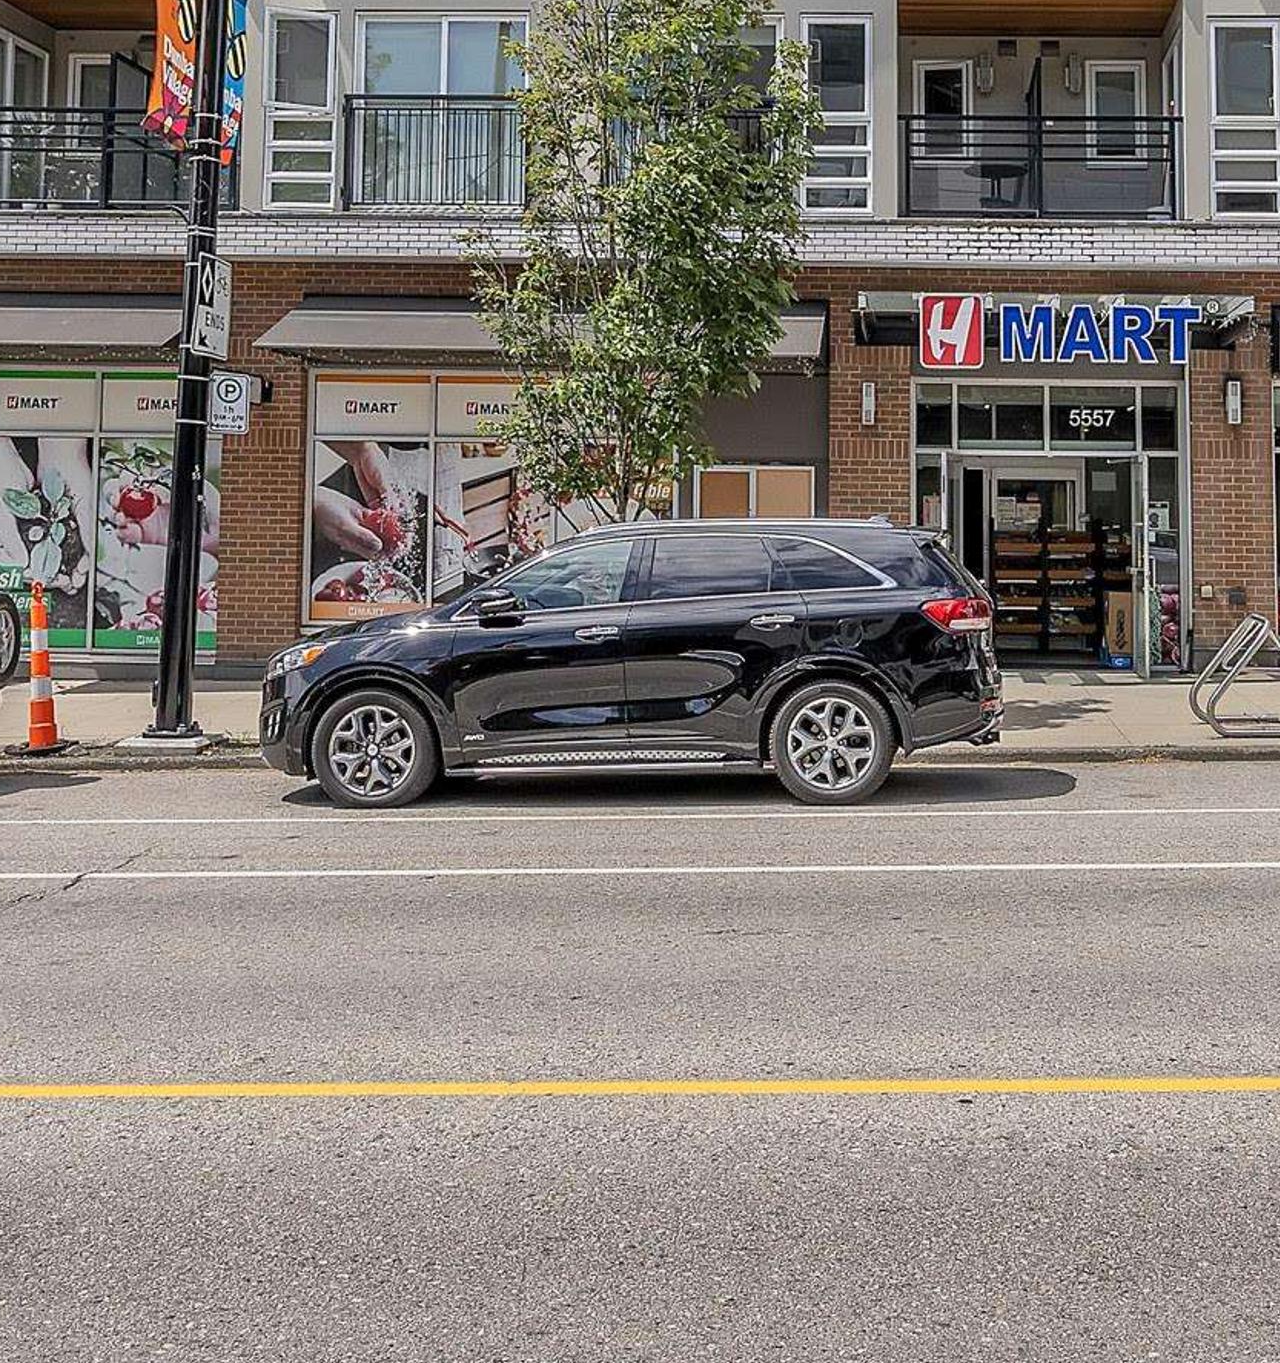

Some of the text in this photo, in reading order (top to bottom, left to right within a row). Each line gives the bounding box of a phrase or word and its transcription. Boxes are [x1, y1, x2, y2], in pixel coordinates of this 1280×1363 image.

[163, 34, 195, 80] Dunba
[926, 295, 1202, 366] H MART
[20, 398, 59, 409] MART
[150, 399, 178, 410] MAR
[359, 402, 397, 414] MART
[1069, 409, 1116, 427] 5557
